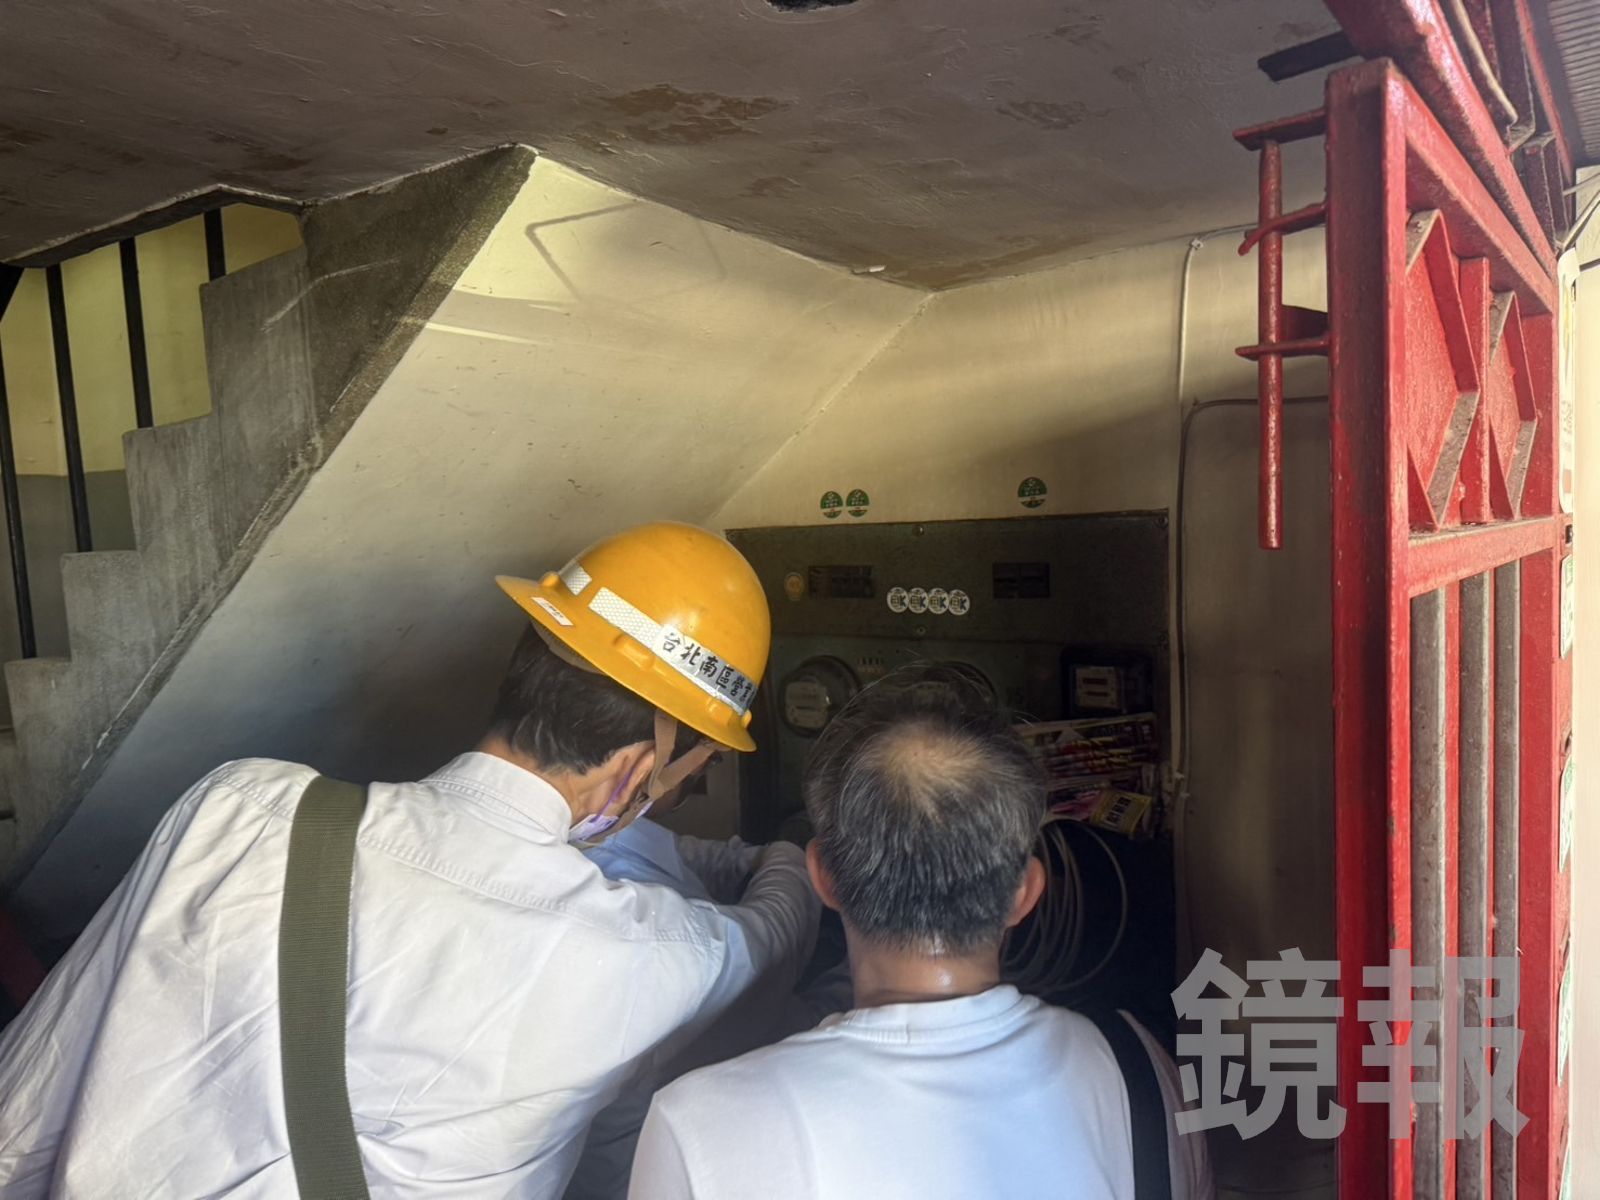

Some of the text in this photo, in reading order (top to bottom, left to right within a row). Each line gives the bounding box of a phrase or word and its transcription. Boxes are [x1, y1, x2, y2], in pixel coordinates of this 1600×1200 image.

[663, 632, 753, 704] 台北南區營
